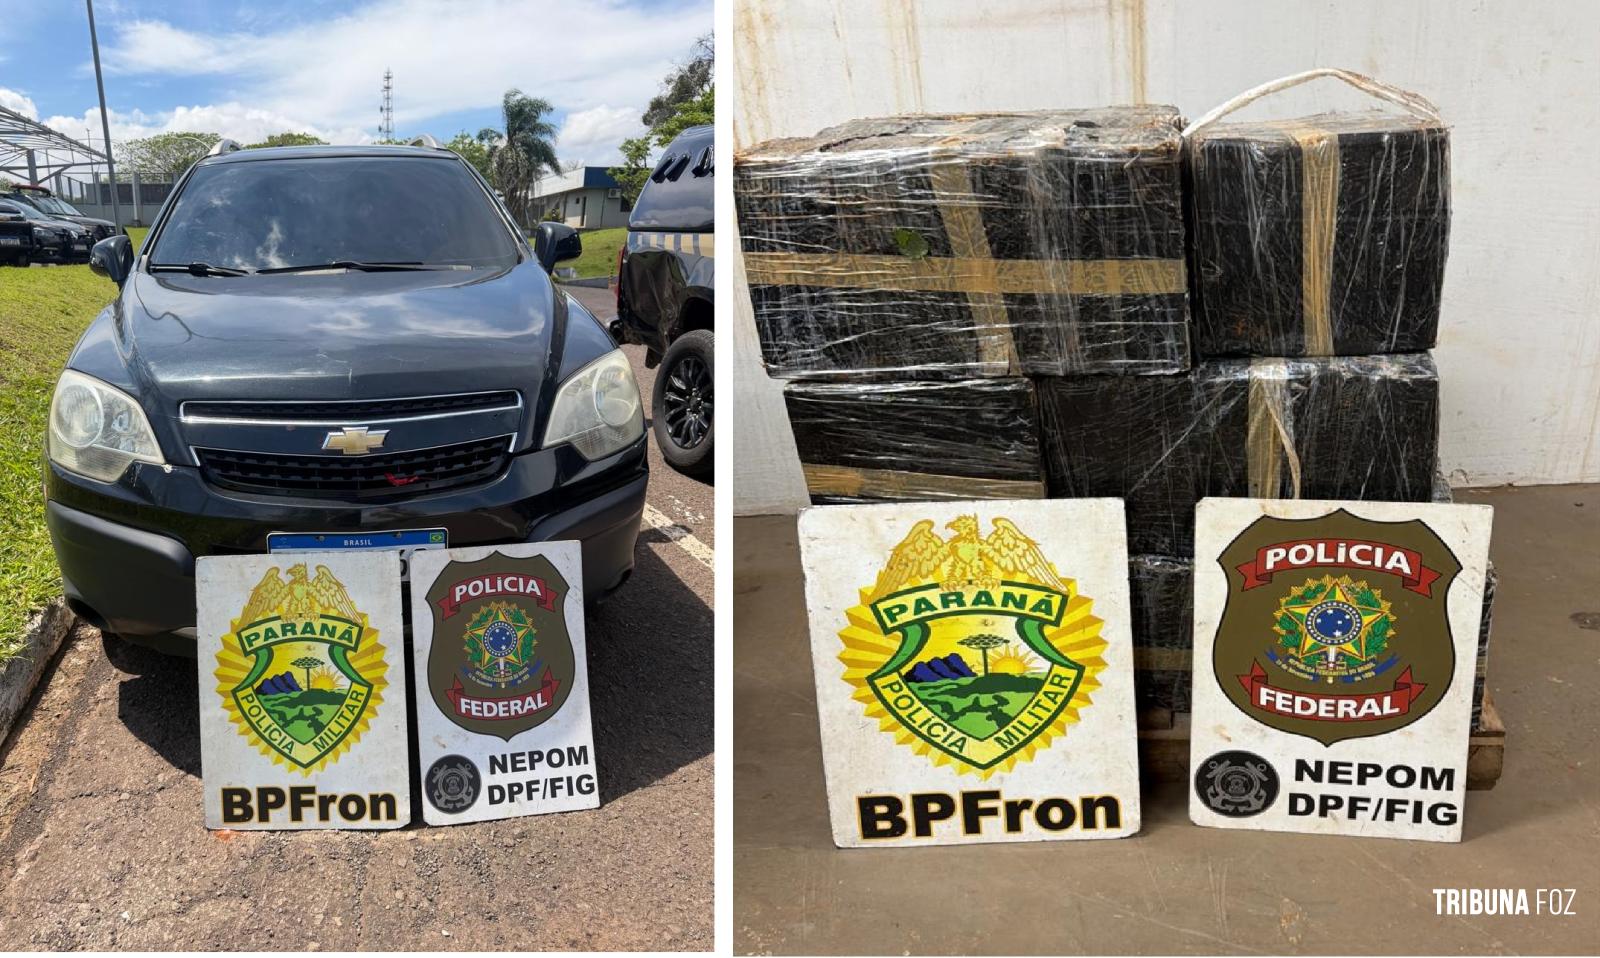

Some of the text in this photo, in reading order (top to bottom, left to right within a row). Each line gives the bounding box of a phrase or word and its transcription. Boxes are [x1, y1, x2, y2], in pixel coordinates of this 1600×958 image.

[1264, 543, 1412, 575] POLÍCIA
[455, 576, 542, 602] POLÍCIA
[882, 589, 1057, 624] PARANÁ
[244, 621, 355, 648] PARANÁ
[460, 692, 548, 719] FEDERAL
[880, 672, 1072, 754] POLÍCIA MILITAR
[1259, 686, 1400, 719] FEDERAL
[240, 689, 365, 755] POLÍCIA MILITAR
[488, 745, 590, 775] NEPOM
[1294, 758, 1456, 792] NEPOM
[221, 785, 398, 824] BPFron
[487, 773, 596, 806] DPF/FIG
[856, 790, 1124, 840] BPFron
[1288, 793, 1459, 827] DPF/FIG
